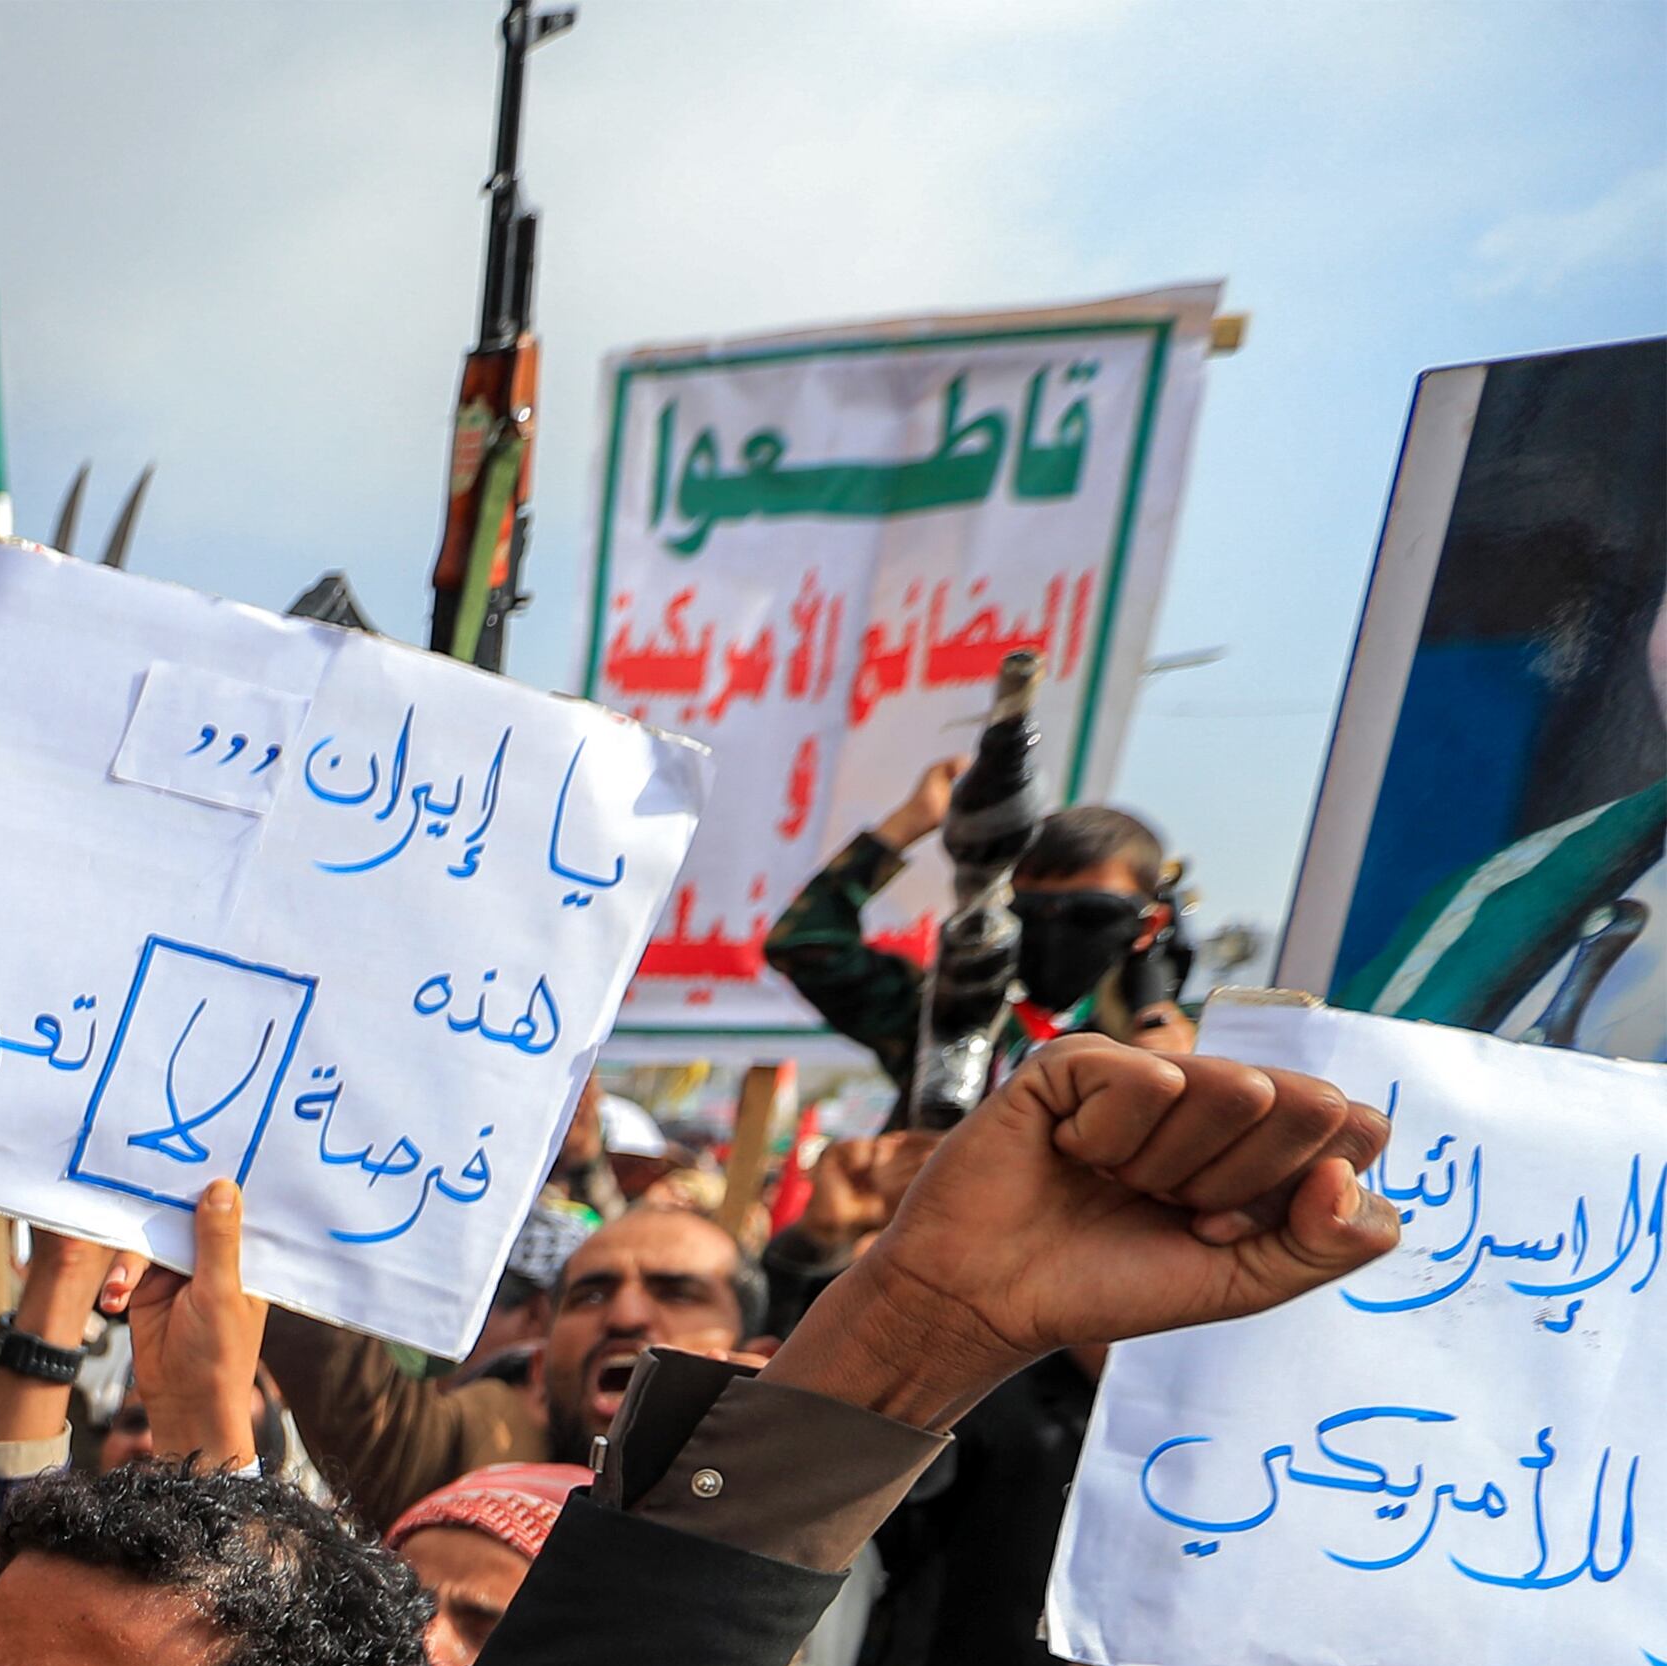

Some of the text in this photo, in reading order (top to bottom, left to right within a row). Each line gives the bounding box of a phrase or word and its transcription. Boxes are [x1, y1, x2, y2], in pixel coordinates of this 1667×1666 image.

[647, 358, 1101, 560] قاطعوا
[604, 568, 843, 725] الأمريكية
[303, 703, 513, 879] إيران
[547, 736, 625, 907] يا
[126, 998, 276, 1163] لا
[414, 968, 560, 1054] هذه
[294, 1064, 494, 1242] فرصة
[1140, 1405, 1640, 1589] للأمريكي
